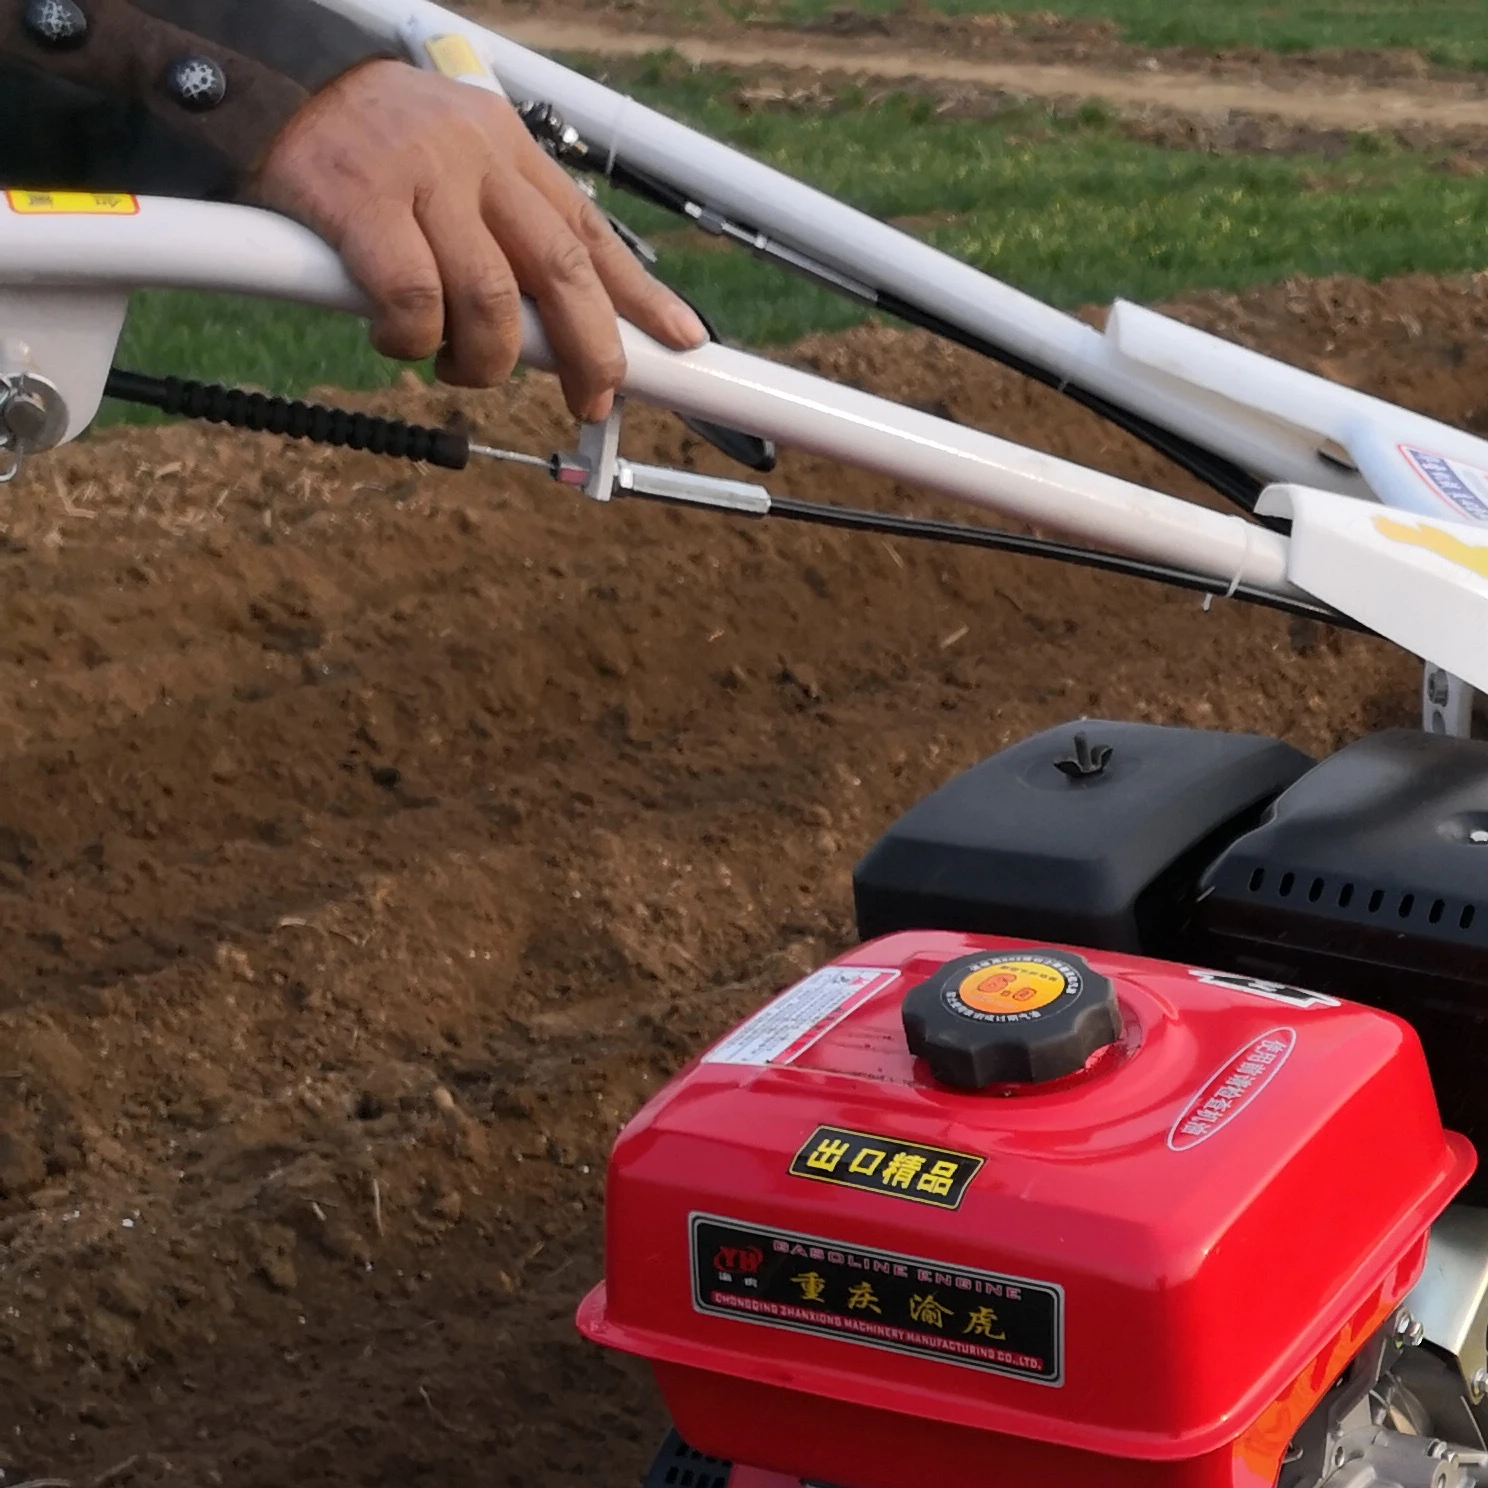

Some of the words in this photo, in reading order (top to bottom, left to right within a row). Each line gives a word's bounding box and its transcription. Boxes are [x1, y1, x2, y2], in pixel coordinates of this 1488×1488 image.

[1181, 1040, 1287, 1135] 使用前请检查机油
[807, 1139, 958, 1196] 出口精品
[773, 1239, 908, 1278] GASOLINE
[917, 1270, 1022, 1301] ENGINE
[715, 1292, 778, 1315] CHONGQING
[780, 1304, 842, 1328] ZHANXIONG
[843, 1317, 903, 1341] MACHINERY
[905, 1330, 995, 1360] MANUFACTURING
[790, 1271, 1006, 1340] 重庆渝虎
